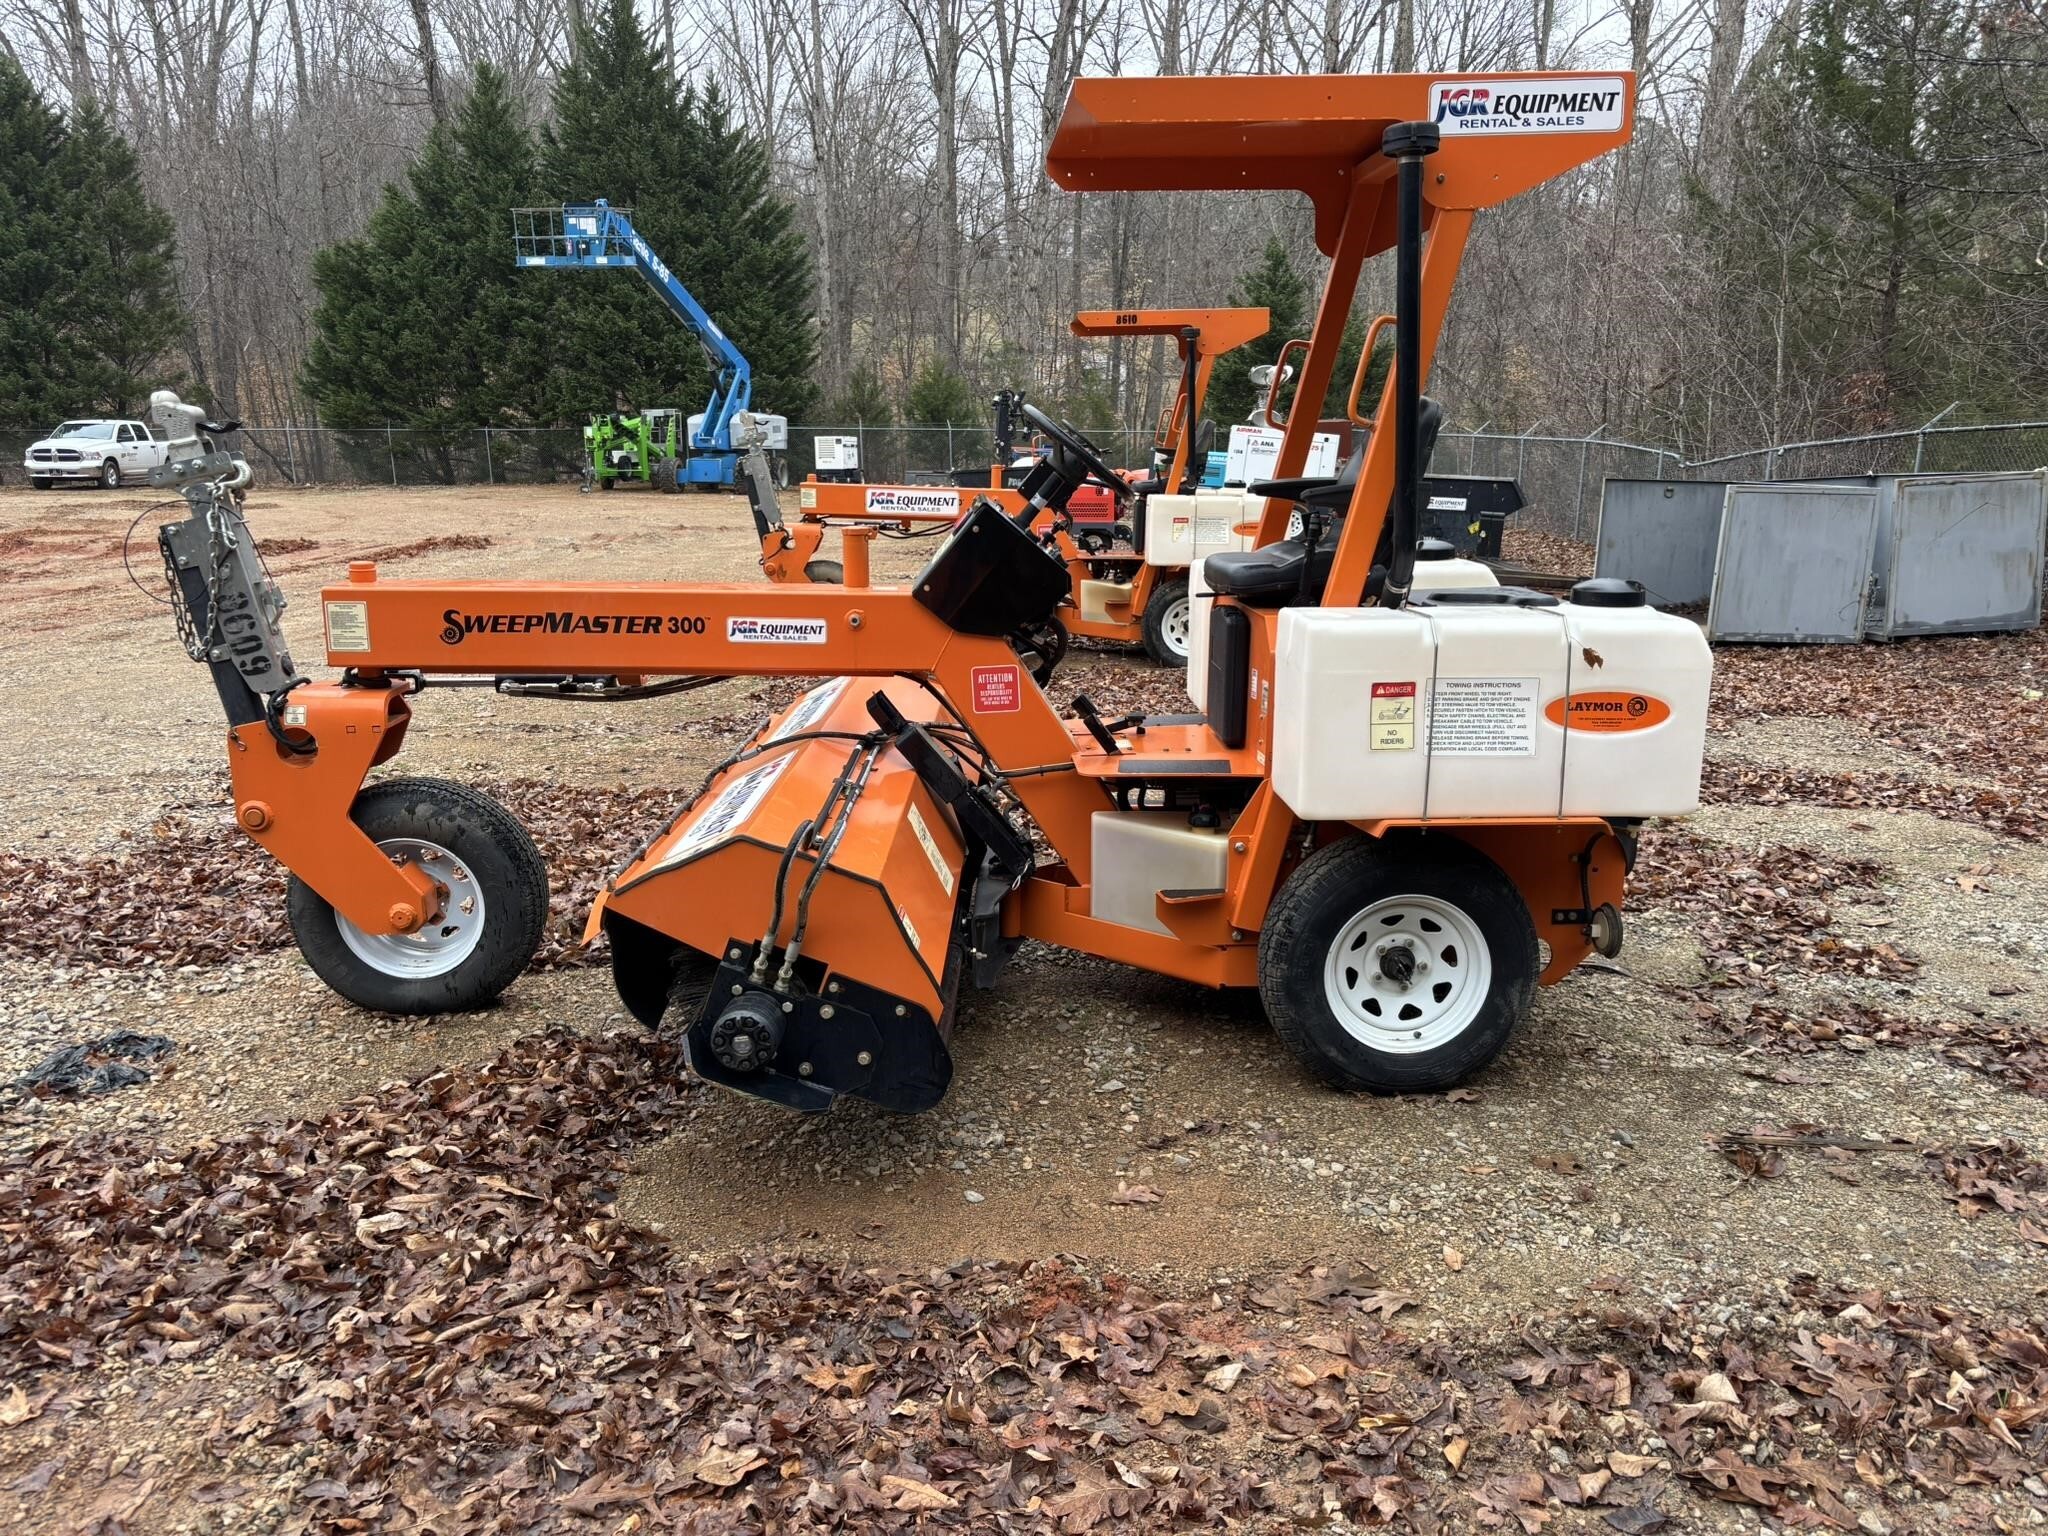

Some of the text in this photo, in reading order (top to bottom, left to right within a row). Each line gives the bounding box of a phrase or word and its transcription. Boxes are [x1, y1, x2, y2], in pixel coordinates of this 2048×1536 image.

[1436, 88, 1620, 124] JGR EQUIPMENT
[1460, 116, 1585, 128] RENTAL & SALES
[651, 255, 670, 283] S-85
[1116, 314, 1138, 324] 8610
[869, 492, 895, 508] JGR
[897, 495, 956, 509] EQUIPMENT
[668, 616, 706, 634] 300
[730, 620, 824, 637] JGR EQUIPMENT
[217, 592, 272, 676] 8609
[978, 672, 1012, 684] ATTENTION
[1386, 686, 1412, 694] DANGER
[1566, 702, 1623, 712] LAYMOR
